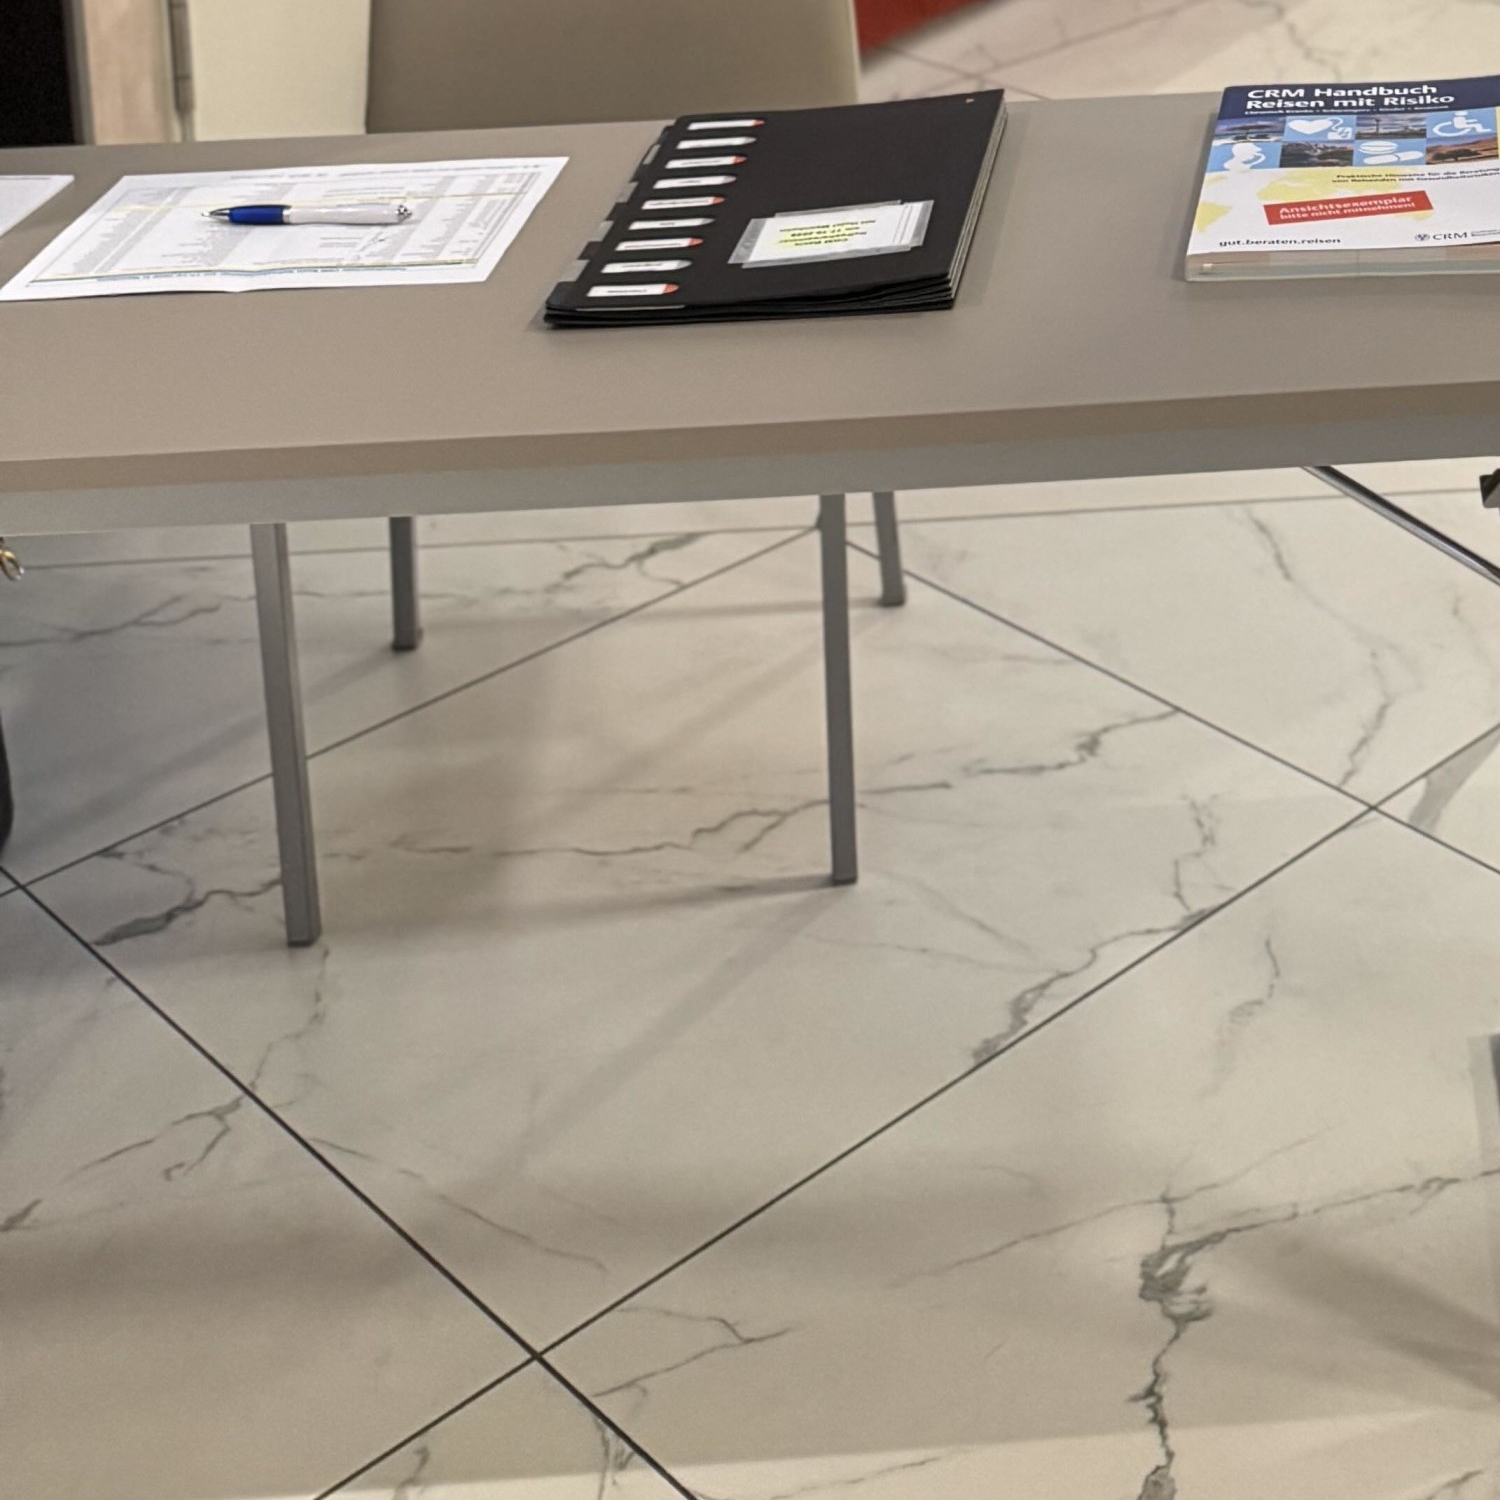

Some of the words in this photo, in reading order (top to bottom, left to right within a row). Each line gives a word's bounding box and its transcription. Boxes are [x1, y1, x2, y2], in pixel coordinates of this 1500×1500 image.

[1248, 88, 1305, 99] CRM
[1314, 84, 1437, 97] Handbuch
[1246, 99, 1325, 110] Reisen
[1333, 97, 1375, 107] mit
[1383, 95, 1455, 106] Risiko
[1279, 196, 1412, 215] Ansichtsexemplar
[1280, 212, 1310, 220] bitte
[1311, 209, 1342, 217] nicht
[1432, 231, 1468, 240] CRM
[1218, 238, 1341, 247] gut.beraten.reisen
